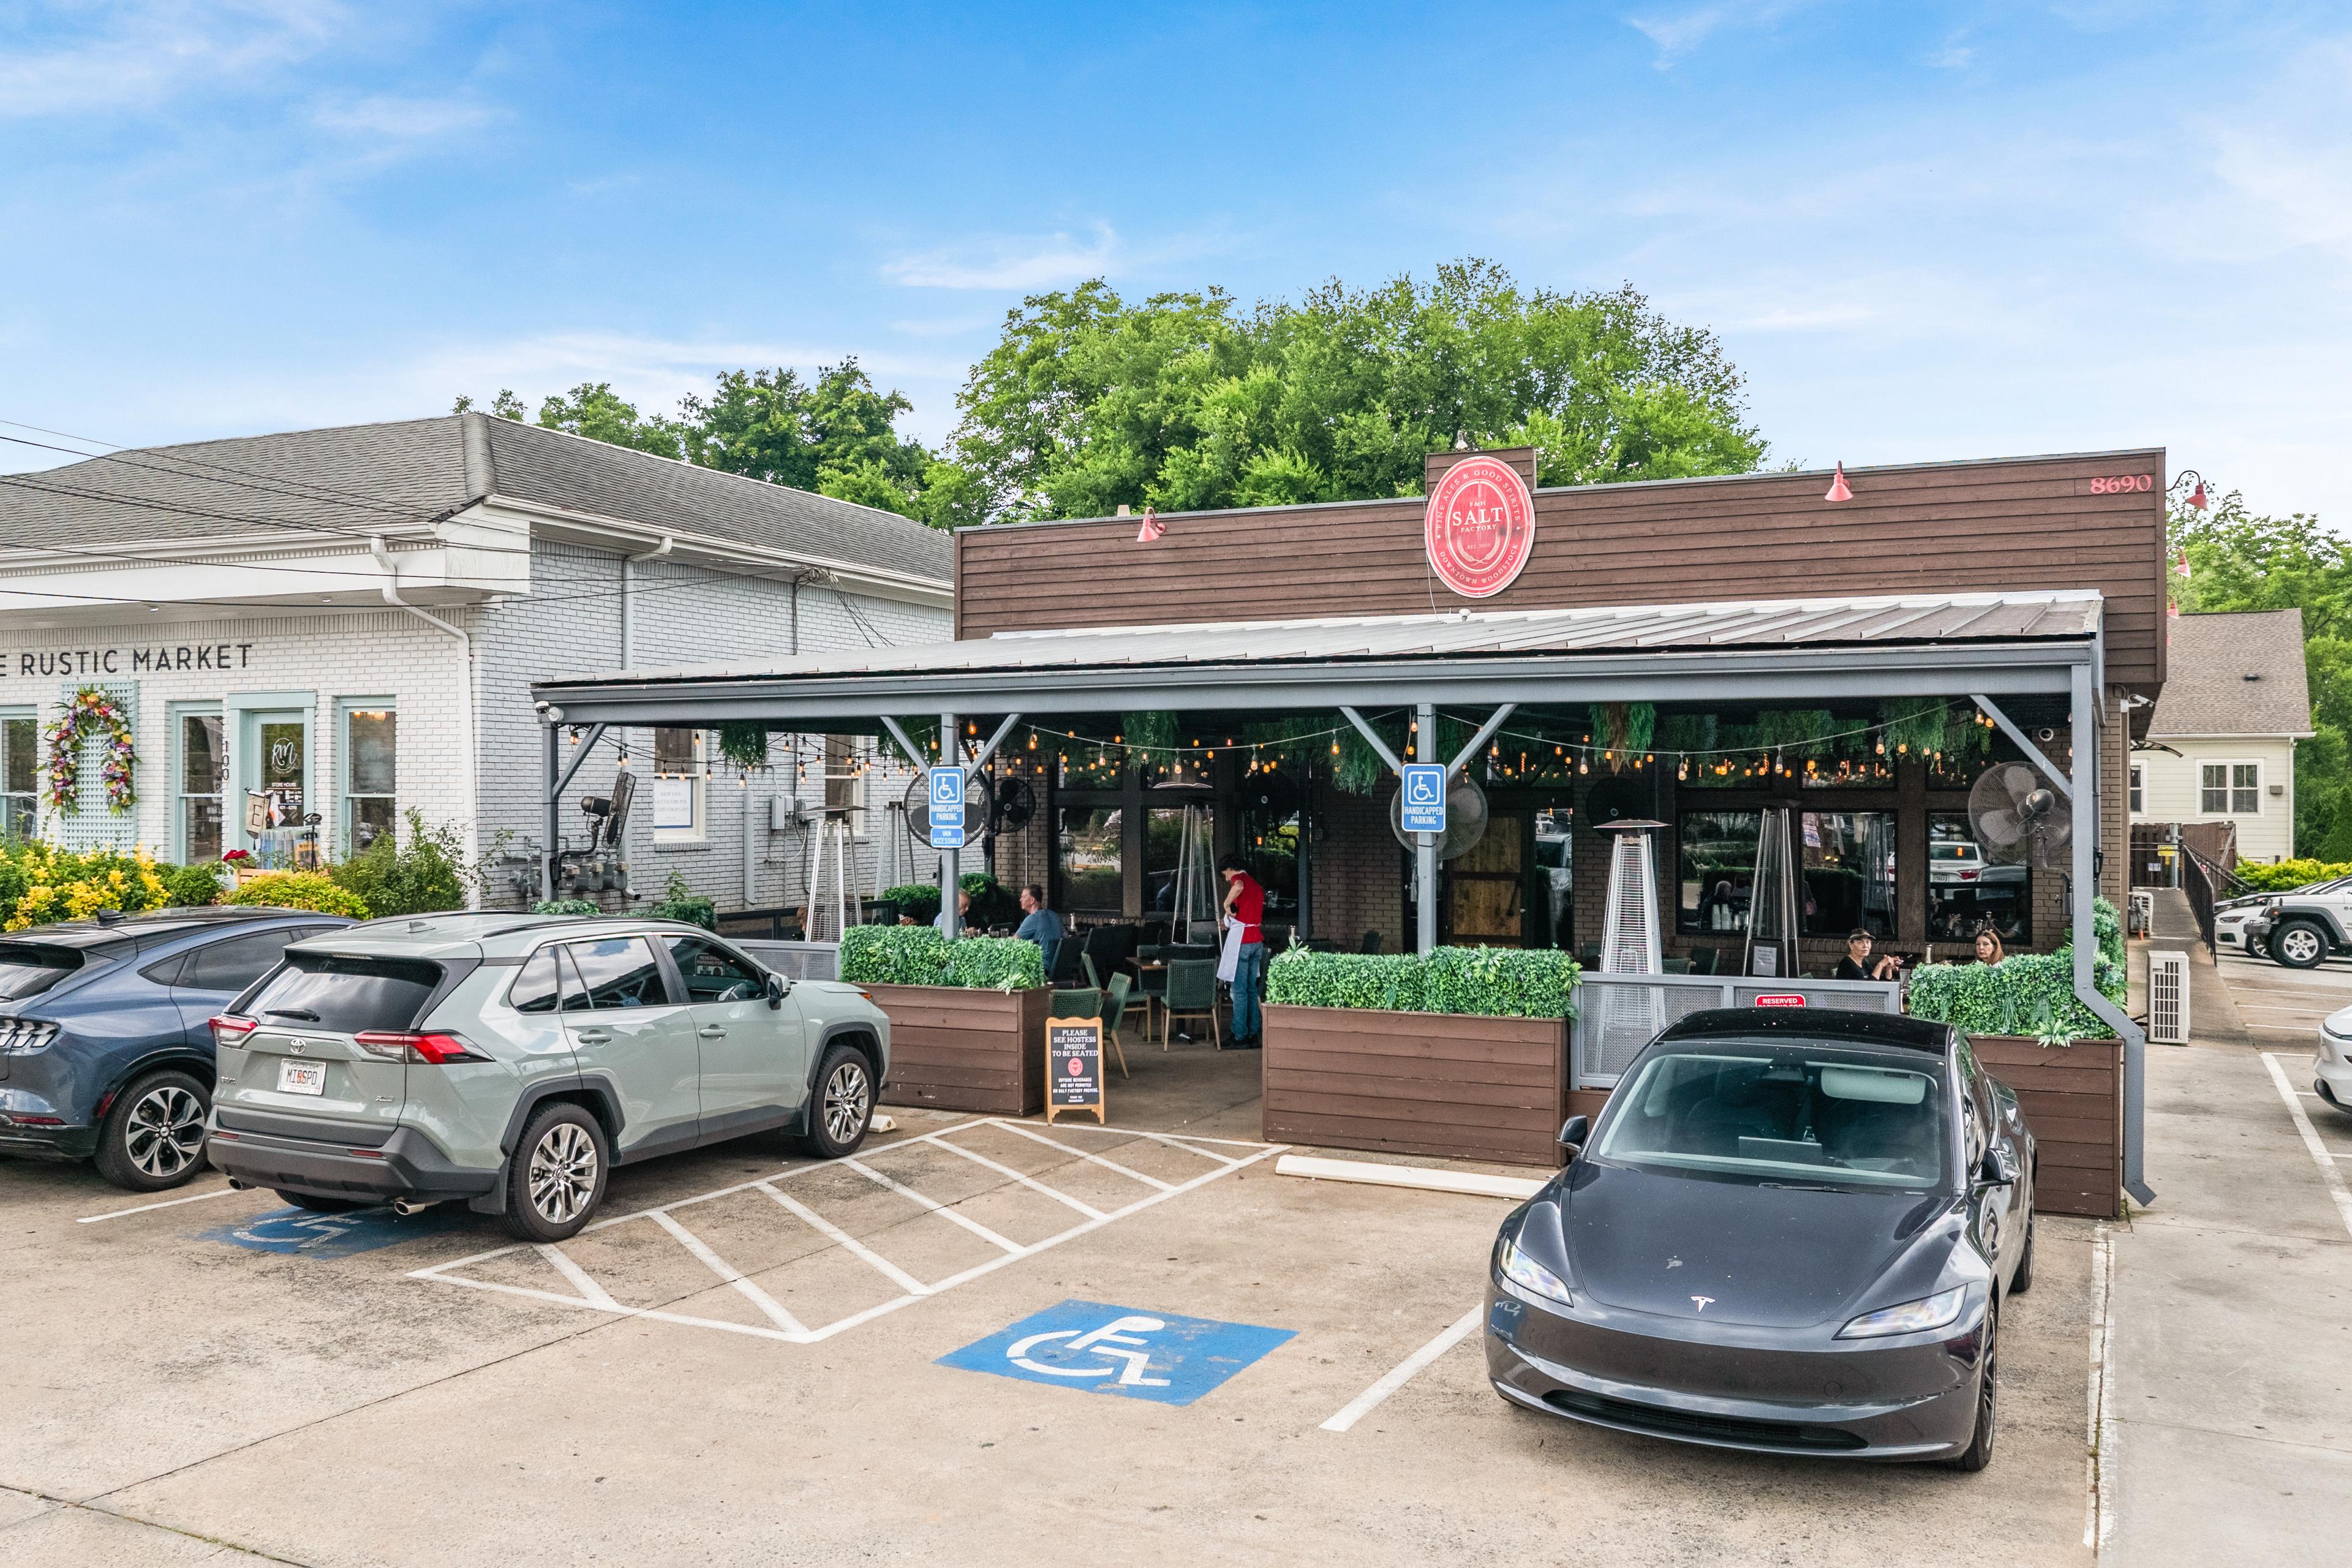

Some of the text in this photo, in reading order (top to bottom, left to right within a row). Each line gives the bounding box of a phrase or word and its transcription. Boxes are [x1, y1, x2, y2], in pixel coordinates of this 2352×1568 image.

[2090, 474, 2152, 494] 8690
[1443, 477, 1460, 501] ALES
[1474, 470, 1502, 483] GOOD
[1502, 482, 1521, 521] SPIRITS
[1452, 507, 1503, 526] SALT
[1461, 524, 1496, 533] FACTORY
[1440, 543, 1518, 584] DOWNTOWN WOODSTOCK
[21, 650, 118, 676] RUSTIC
[133, 644, 252, 672] MARKET
[931, 804, 963, 813] HANDICAPPED
[1404, 806, 1444, 815] HANDICAPPED
[936, 813, 957, 821] PARKING
[1411, 815, 1437, 824] PARKING
